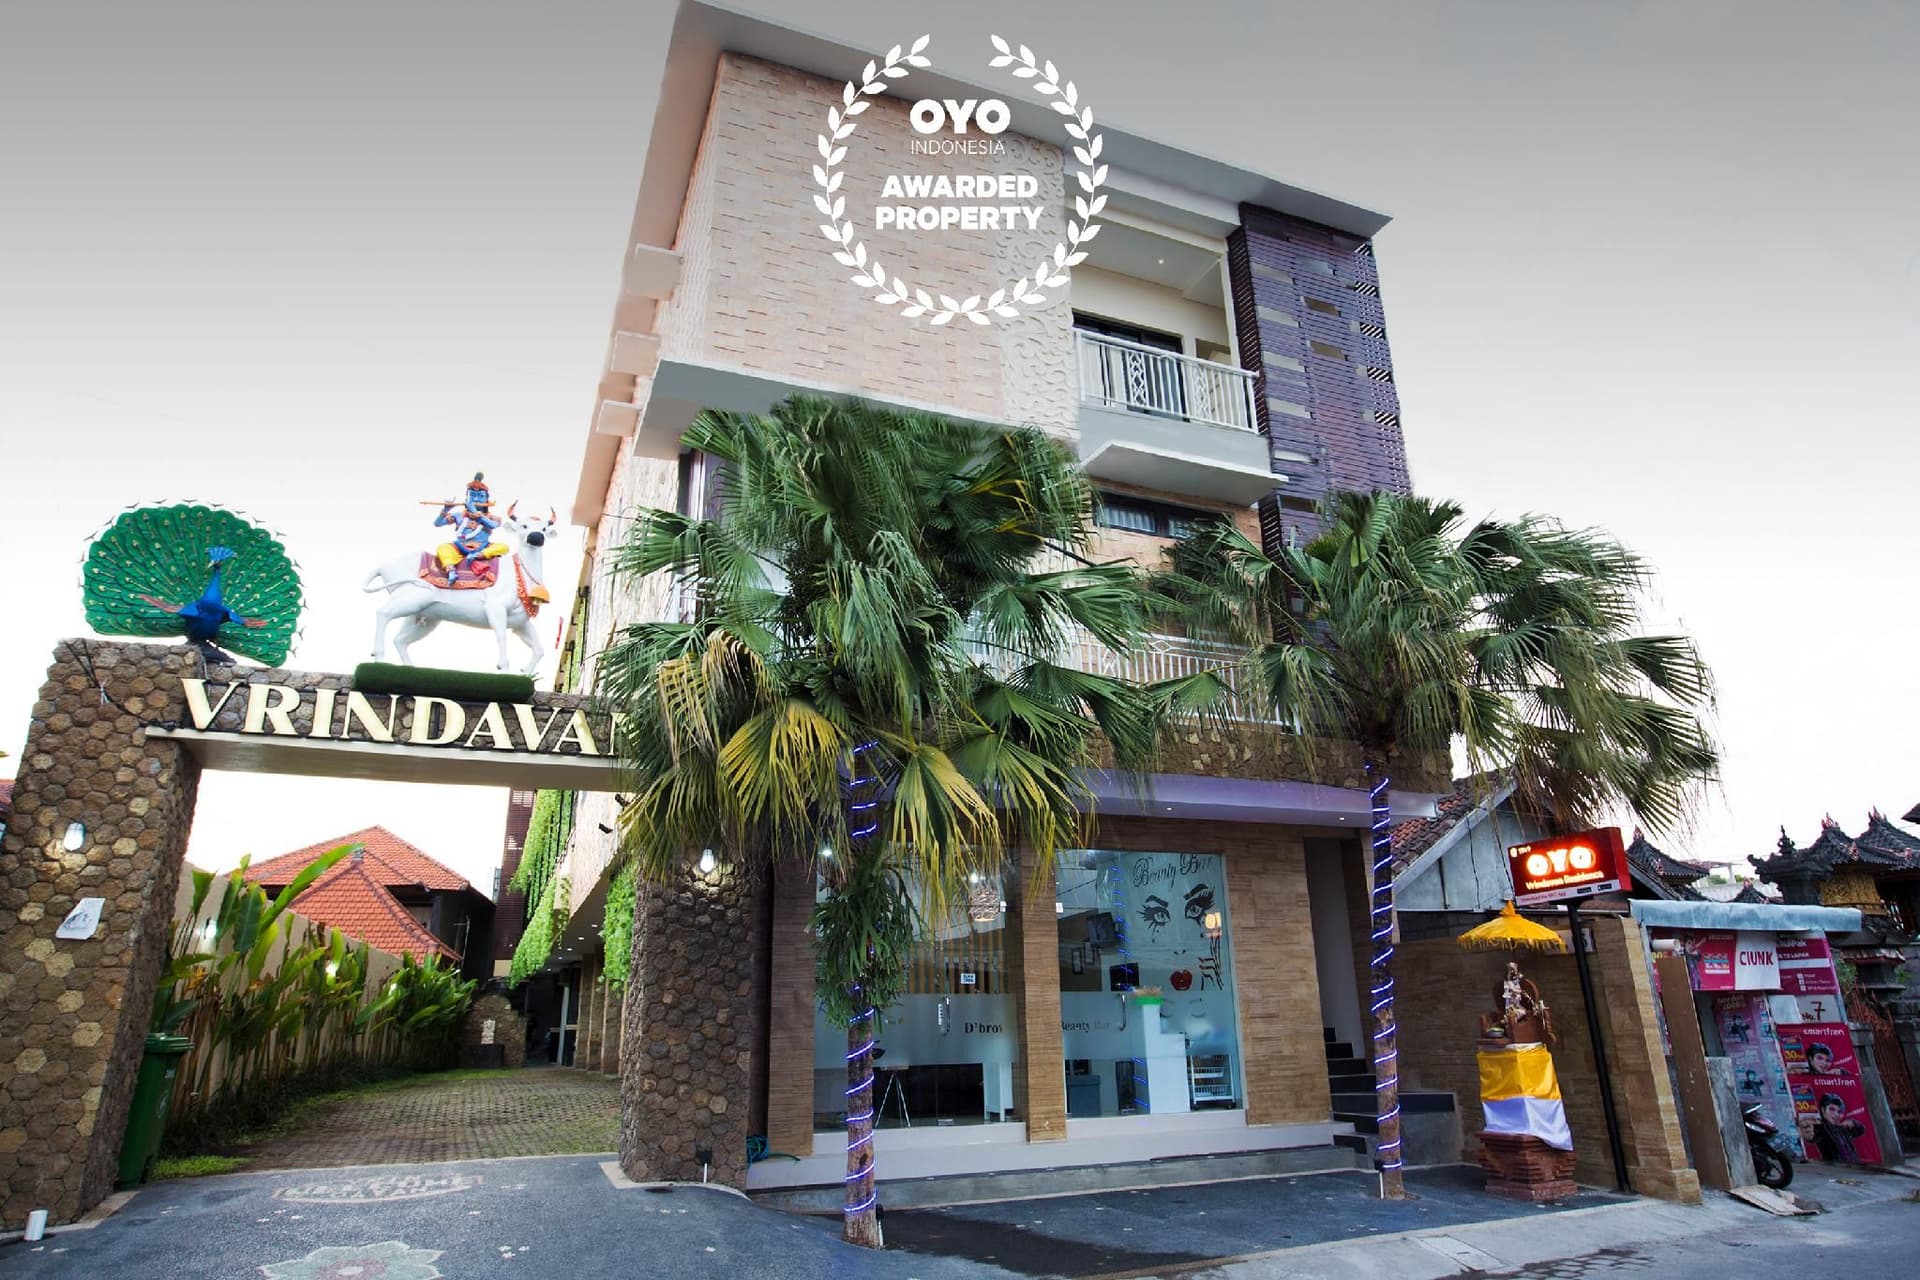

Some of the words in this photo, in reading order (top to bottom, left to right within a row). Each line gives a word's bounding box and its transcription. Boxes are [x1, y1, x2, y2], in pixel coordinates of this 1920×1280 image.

[1526, 846, 1596, 876] OYO
[1739, 951, 1774, 966] CIUNK
[1803, 1027, 1845, 1036] smartfren
[1814, 1077, 1857, 1087] smartfren
